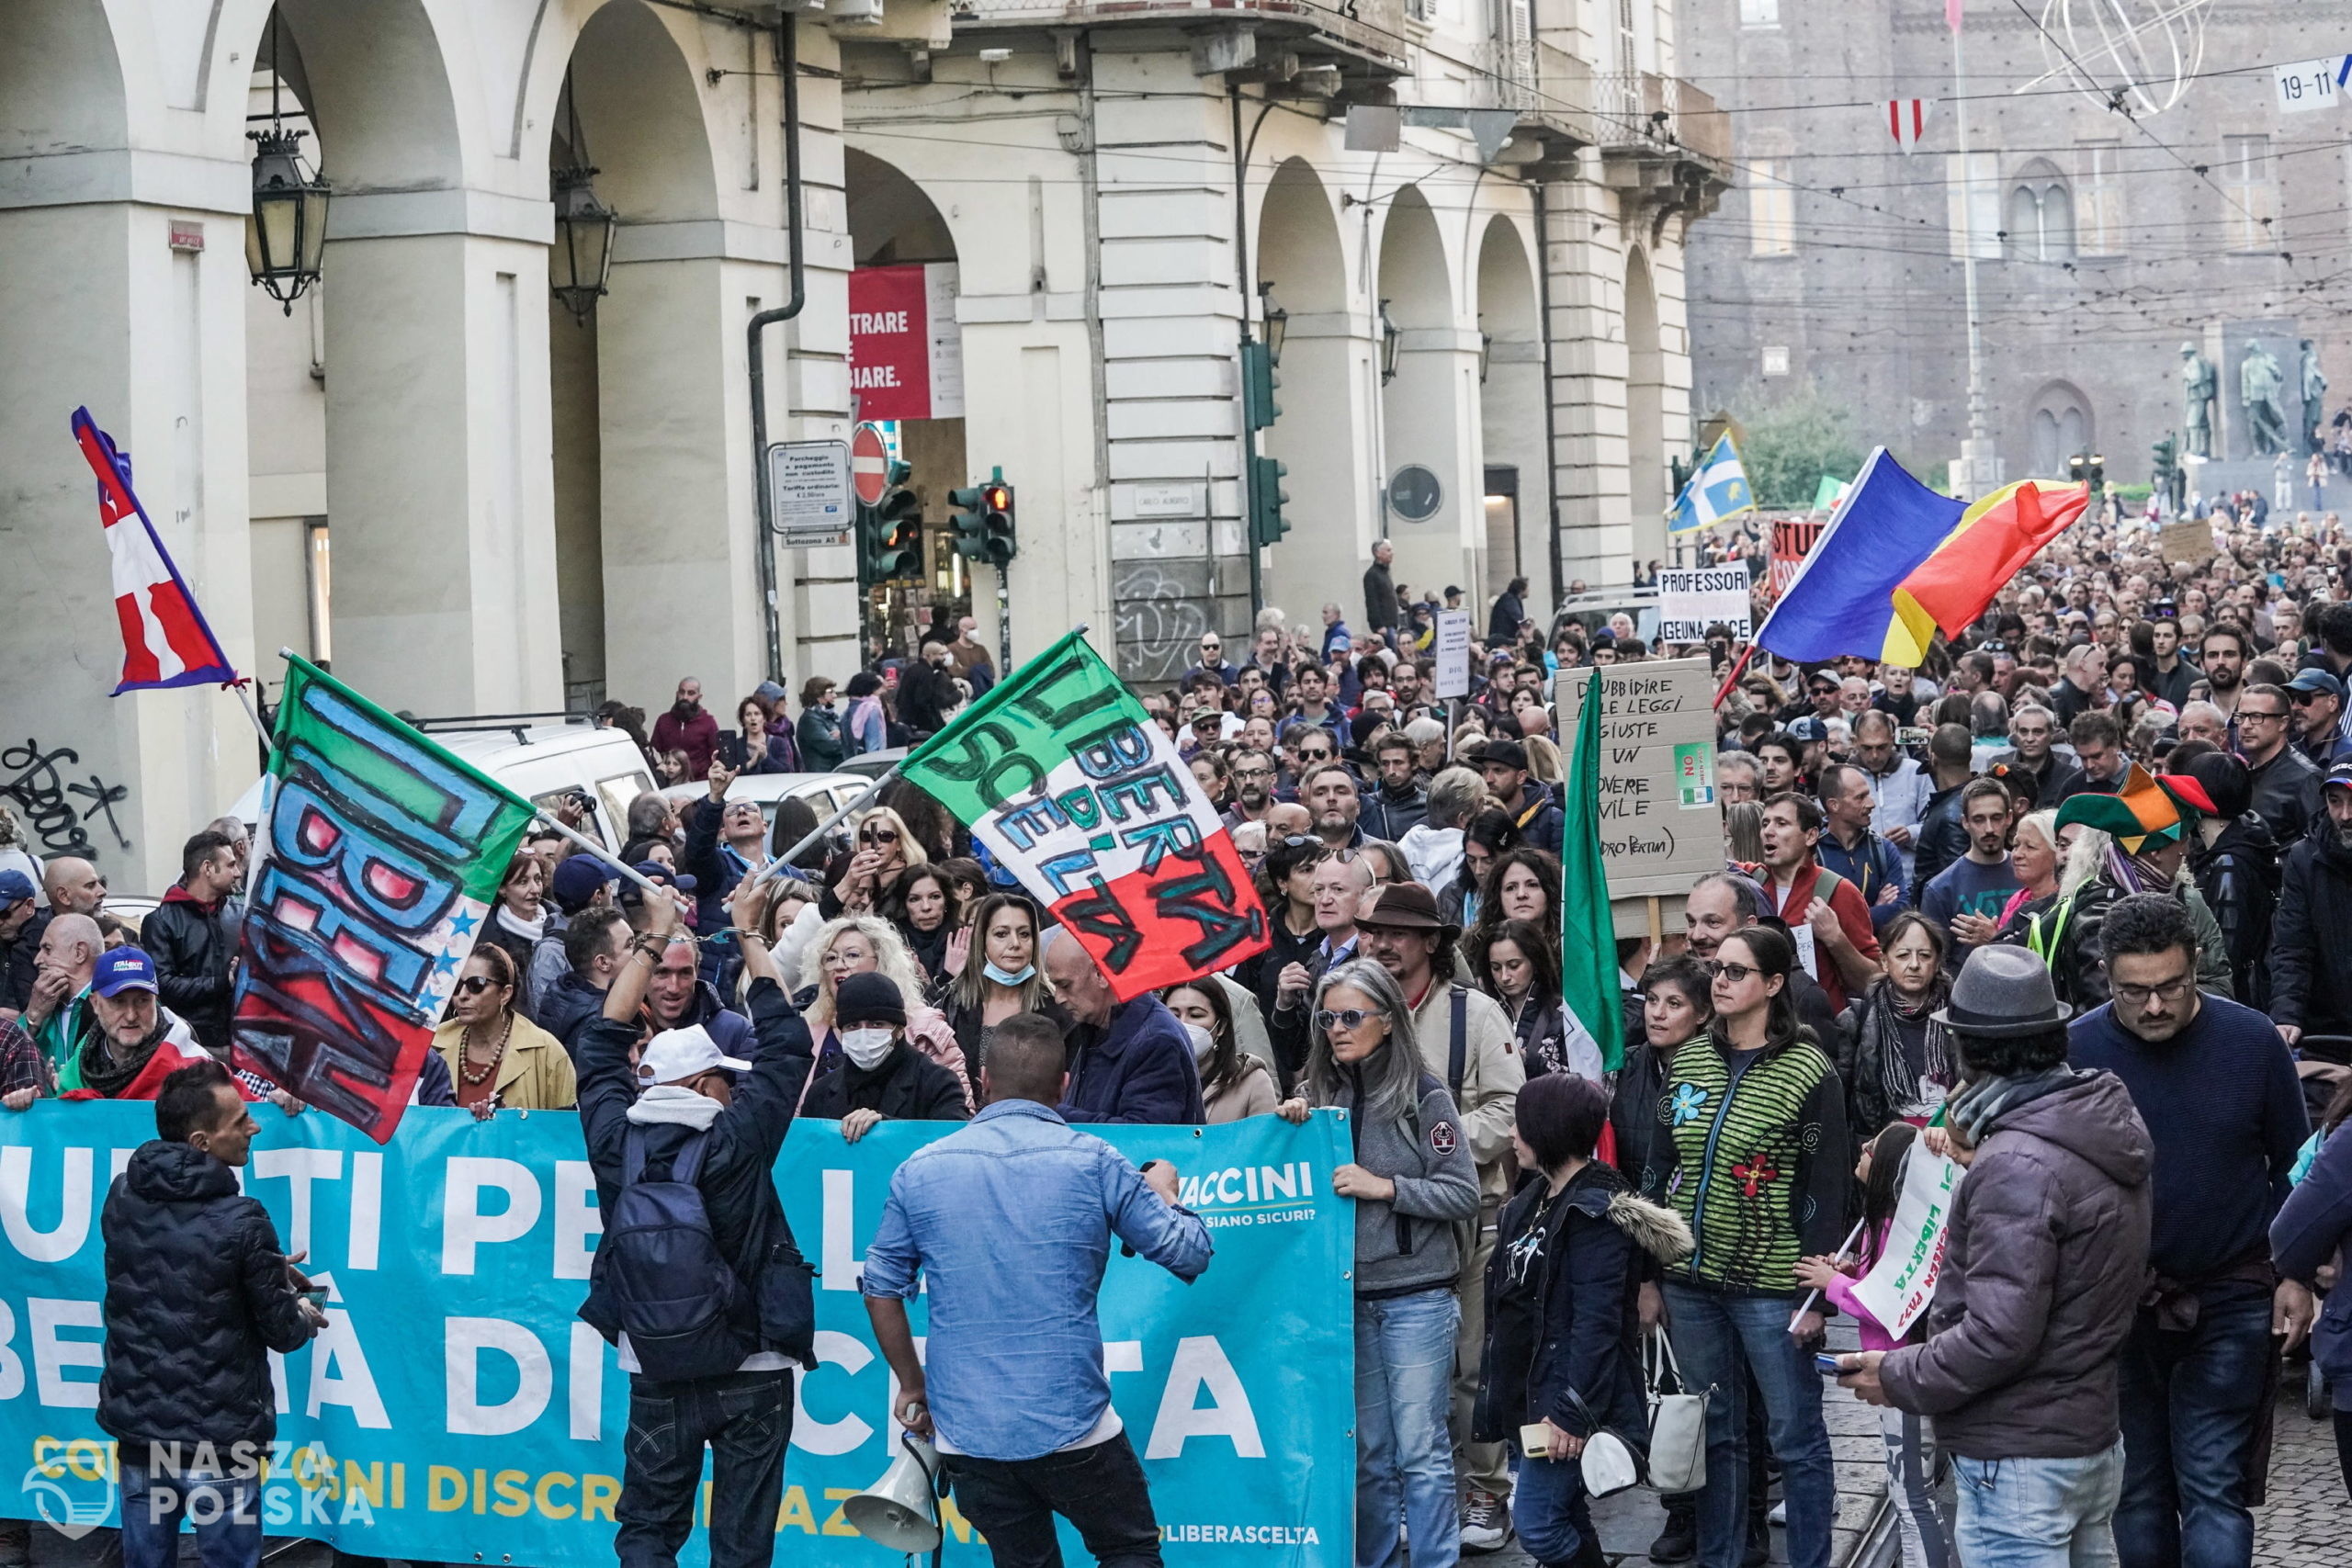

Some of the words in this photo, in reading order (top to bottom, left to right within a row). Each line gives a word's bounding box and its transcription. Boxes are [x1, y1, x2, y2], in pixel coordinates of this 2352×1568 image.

[2281, 72, 2330, 100] 19-11
[850, 310, 909, 335] TRARE
[1662, 570, 1747, 593] PROFESSORI
[1627, 695, 1683, 715] LEGGI
[1600, 722, 1657, 739] GIUSTE
[1613, 746, 1642, 764] UN
[1684, 756, 1695, 776] NO
[1599, 774, 1649, 795] OVERE
[1599, 797, 1651, 820] VILE
[923, 721, 1144, 975] SCELTA
[1600, 840, 1626, 858] DRO
[441, 1156, 605, 1280] PE
[1205, 1213, 1253, 1229] SIANO
[1257, 1209, 1316, 1224] SICURI?
[445, 1316, 605, 1441] DI
[291, 1447, 406, 1509] OGNI
